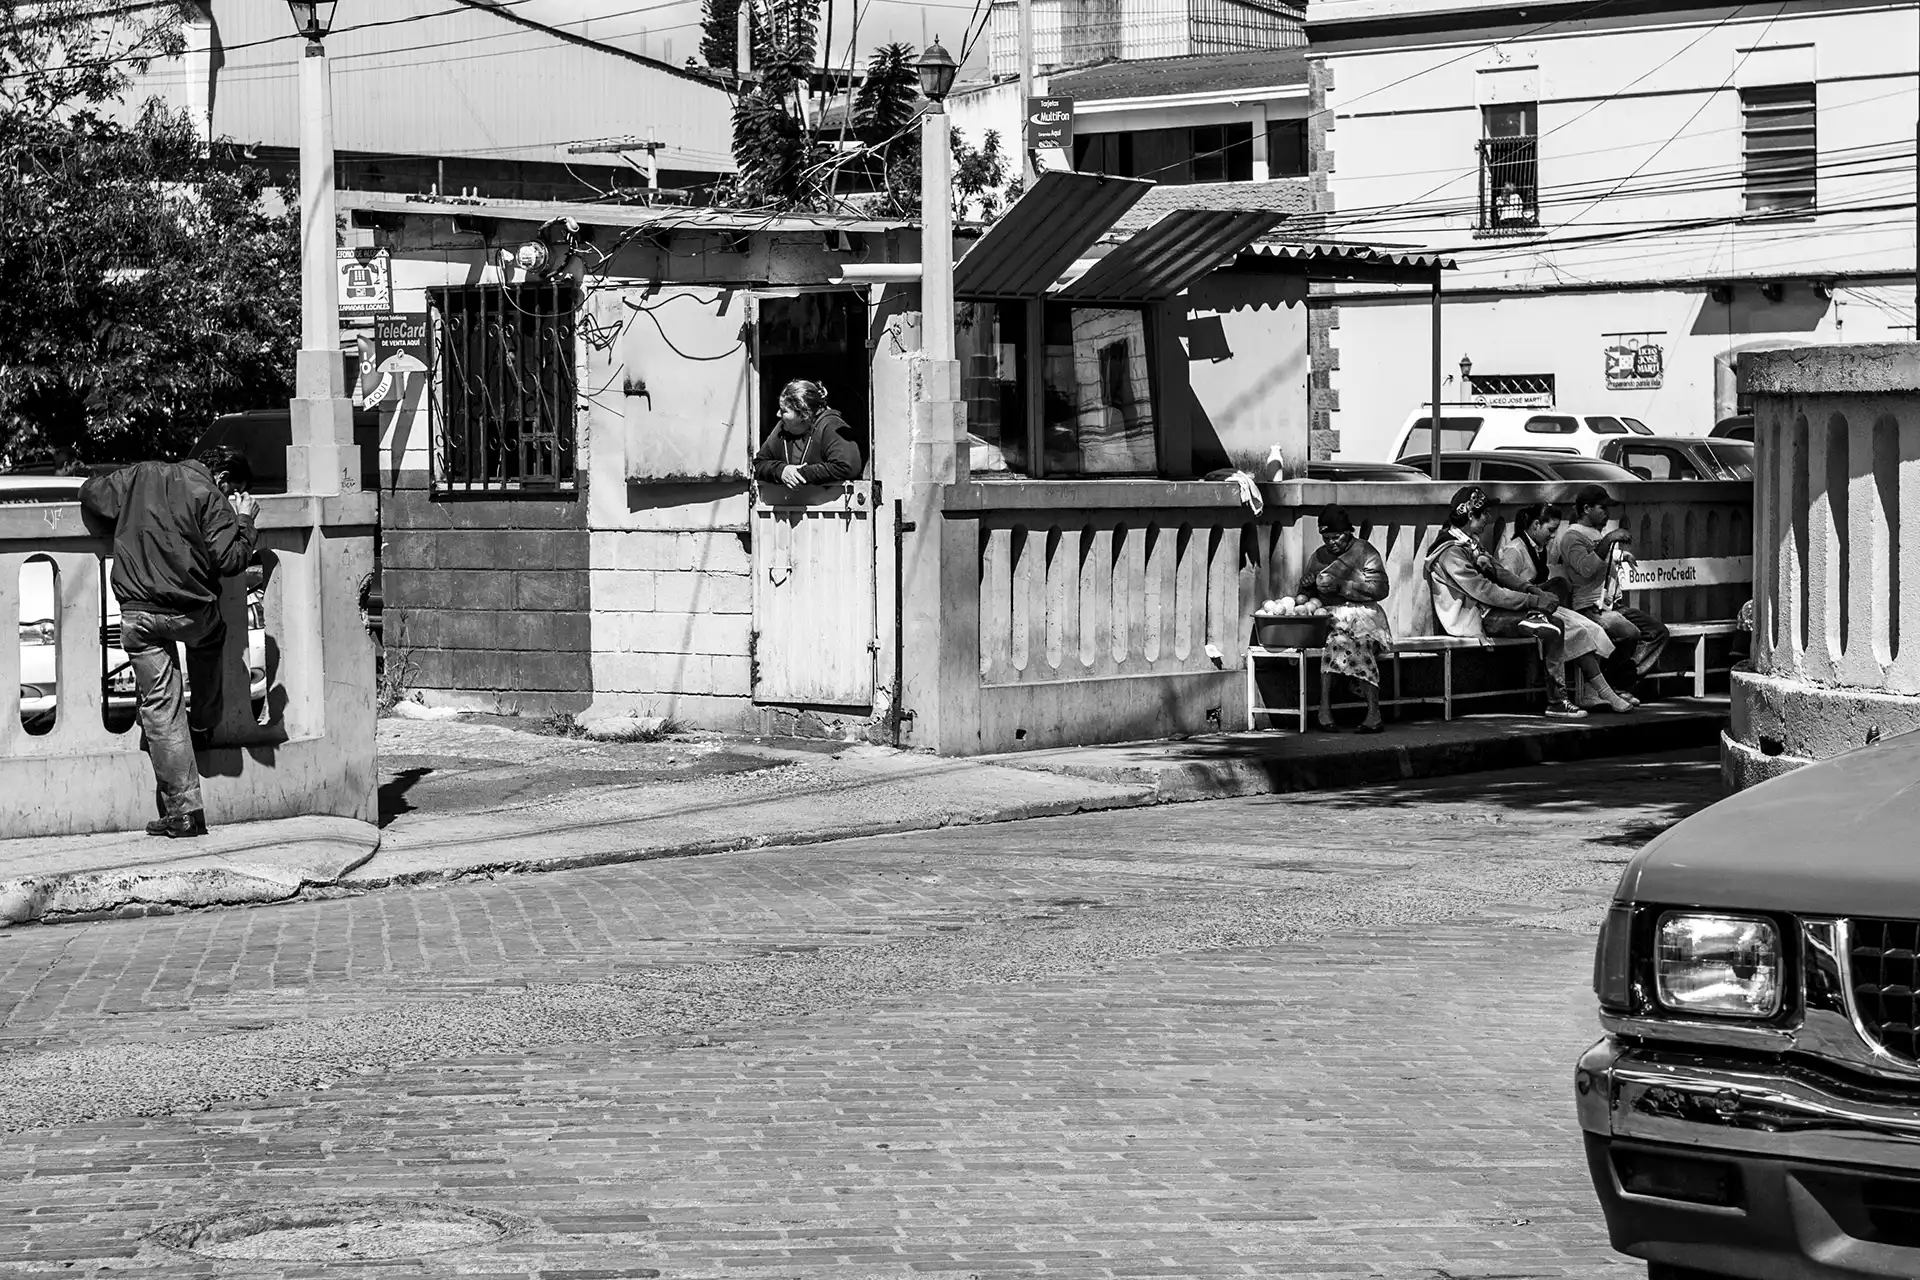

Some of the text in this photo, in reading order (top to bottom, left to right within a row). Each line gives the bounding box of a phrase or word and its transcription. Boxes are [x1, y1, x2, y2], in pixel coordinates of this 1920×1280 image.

[1040, 111, 1070, 121] MultiFon
[377, 322, 427, 339] TeleCard
[1638, 348, 1658, 356] LICEO
[1489, 397, 1507, 405] LICEO
[1629, 566, 1696, 583] Banco ProCredit
